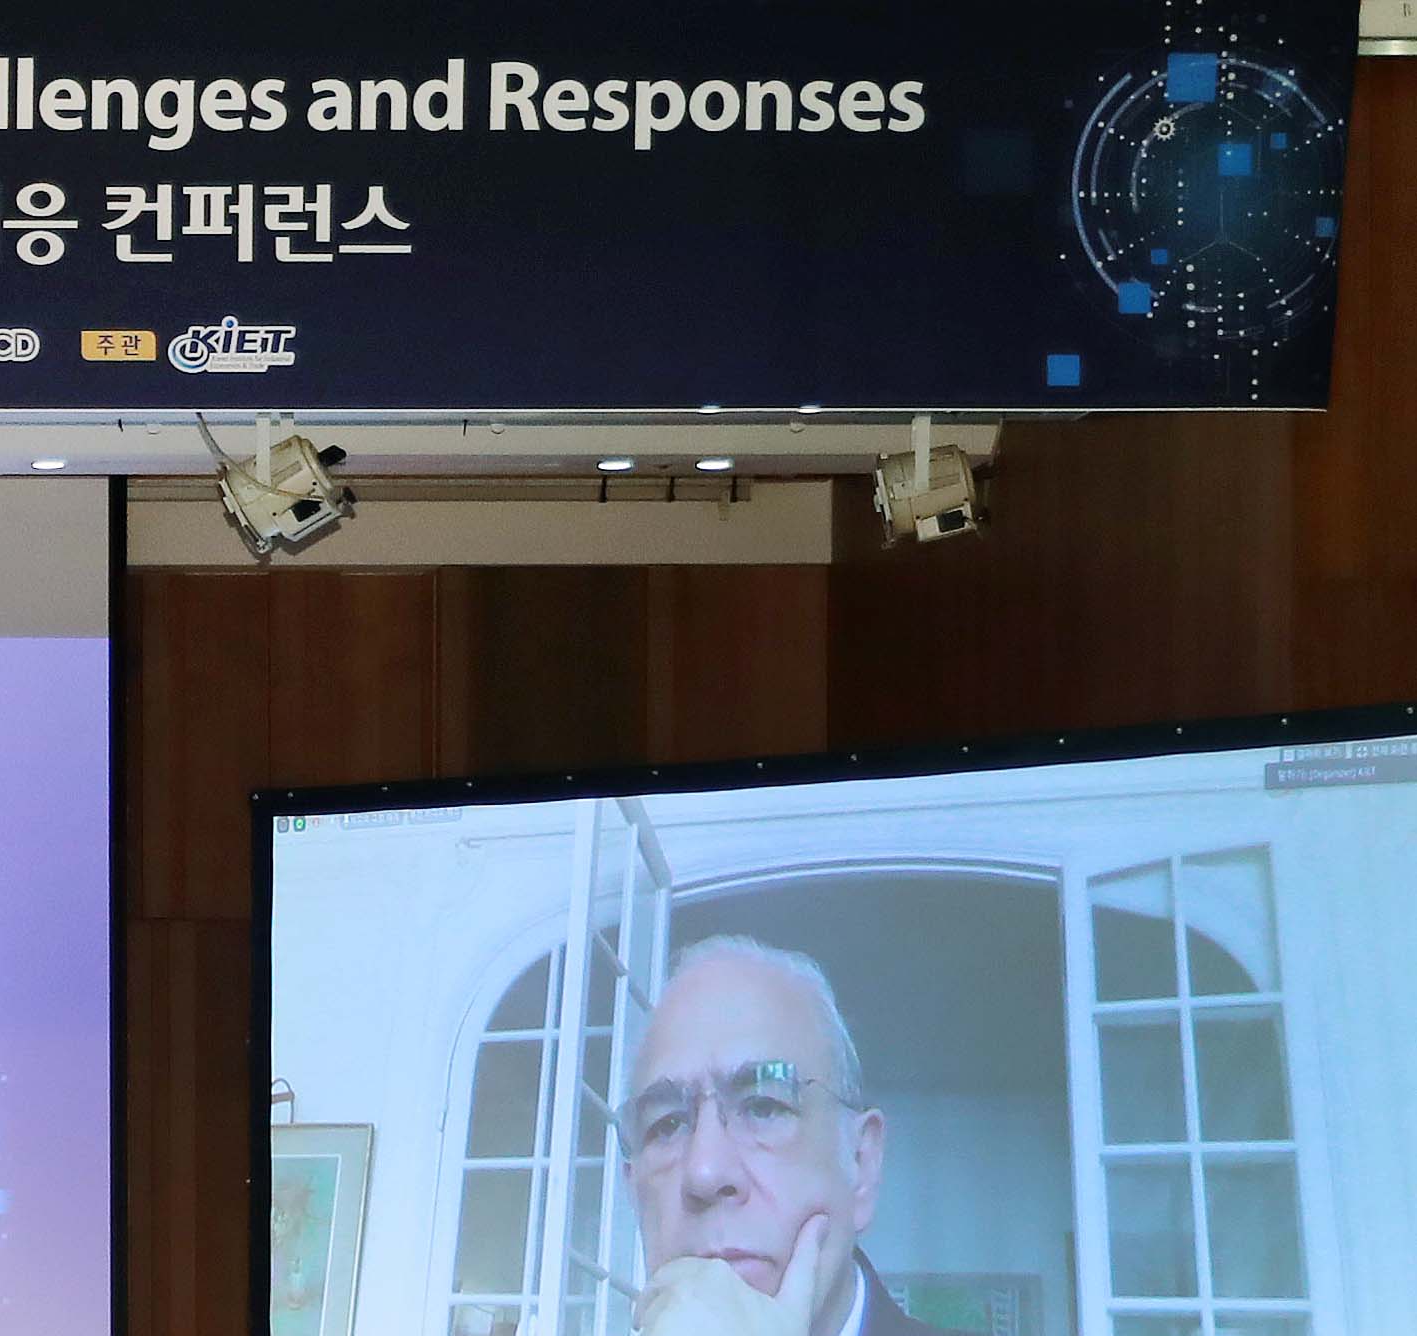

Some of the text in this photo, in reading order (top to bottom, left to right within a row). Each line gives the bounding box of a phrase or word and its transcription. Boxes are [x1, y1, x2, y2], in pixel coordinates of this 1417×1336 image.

[307, 58, 465, 132] and
[489, 61, 926, 151] Responses
[101, 183, 413, 263] 컨퍼런스
